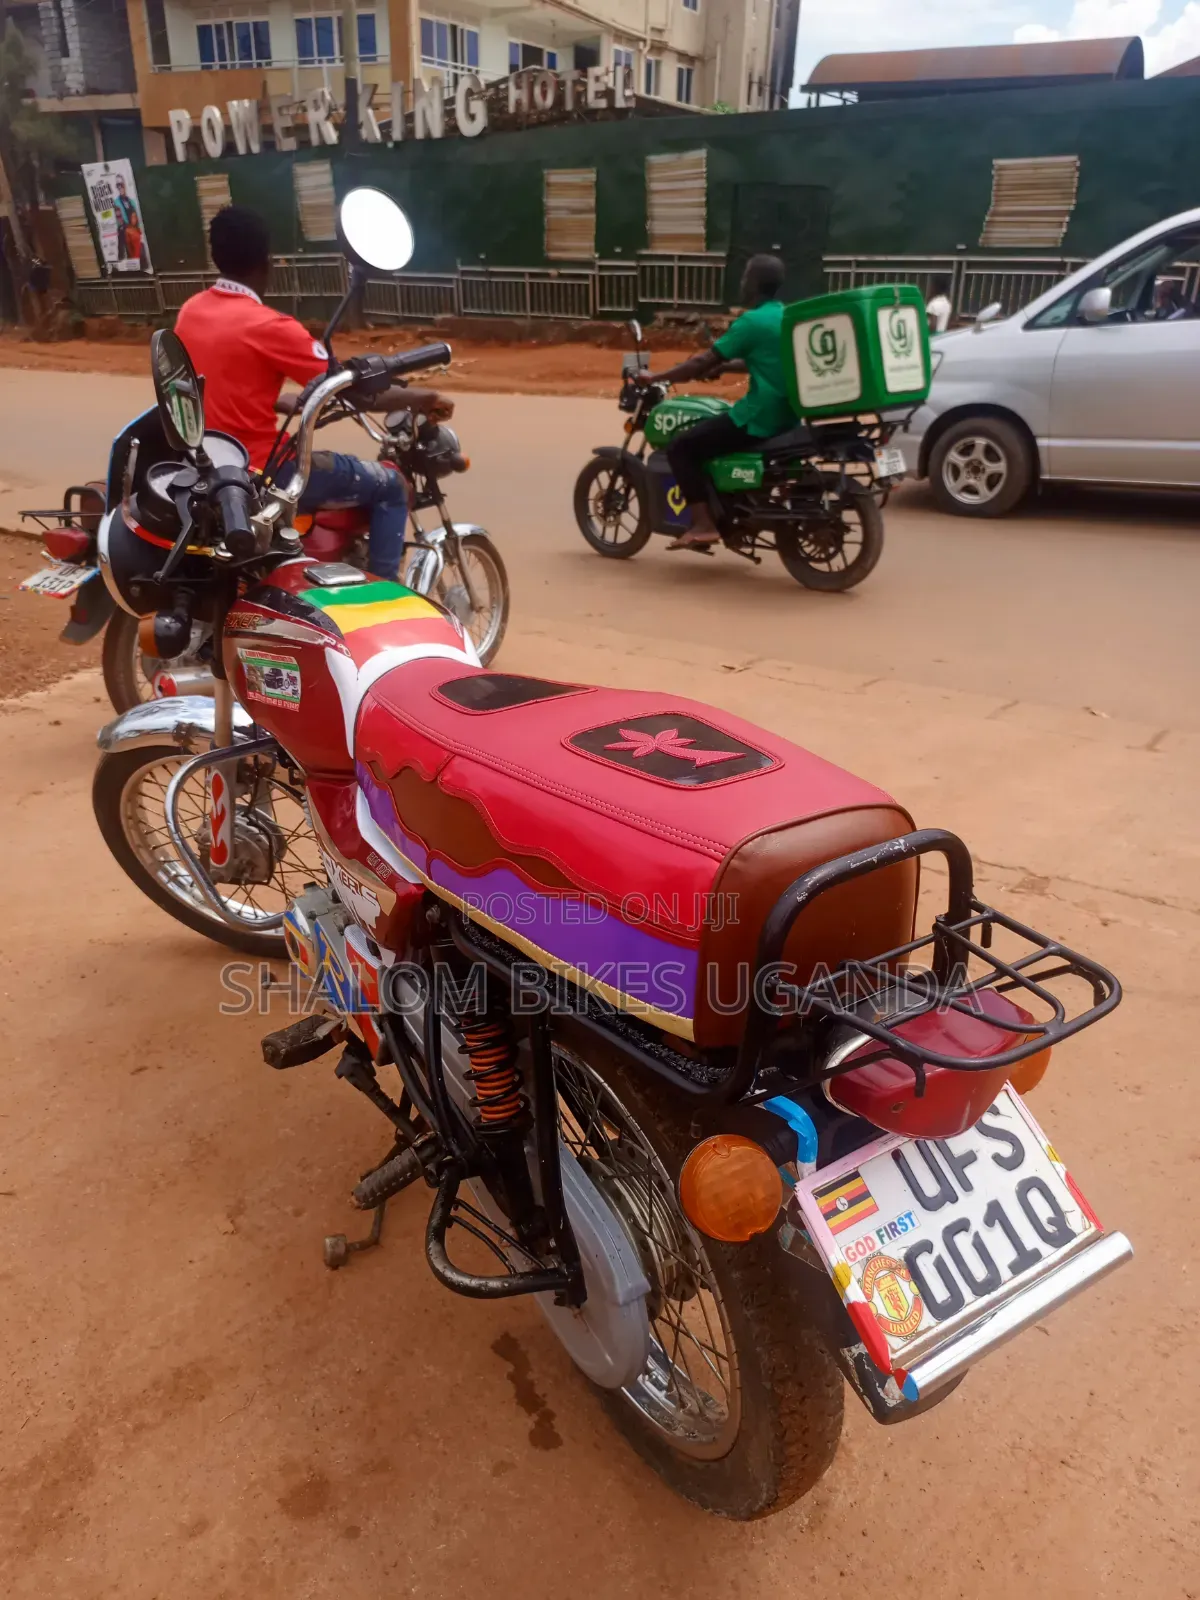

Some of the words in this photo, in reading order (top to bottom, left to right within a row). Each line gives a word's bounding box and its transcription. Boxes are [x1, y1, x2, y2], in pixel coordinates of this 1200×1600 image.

[168, 87, 338, 162] POWER
[357, 73, 488, 143] KING
[508, 65, 636, 114] HOTEL
[890, 1103, 1026, 1212] UFS
[844, 1235, 877, 1263] GOD
[875, 1210, 916, 1246] FIRST
[888, 1310, 921, 1334] UNITED
